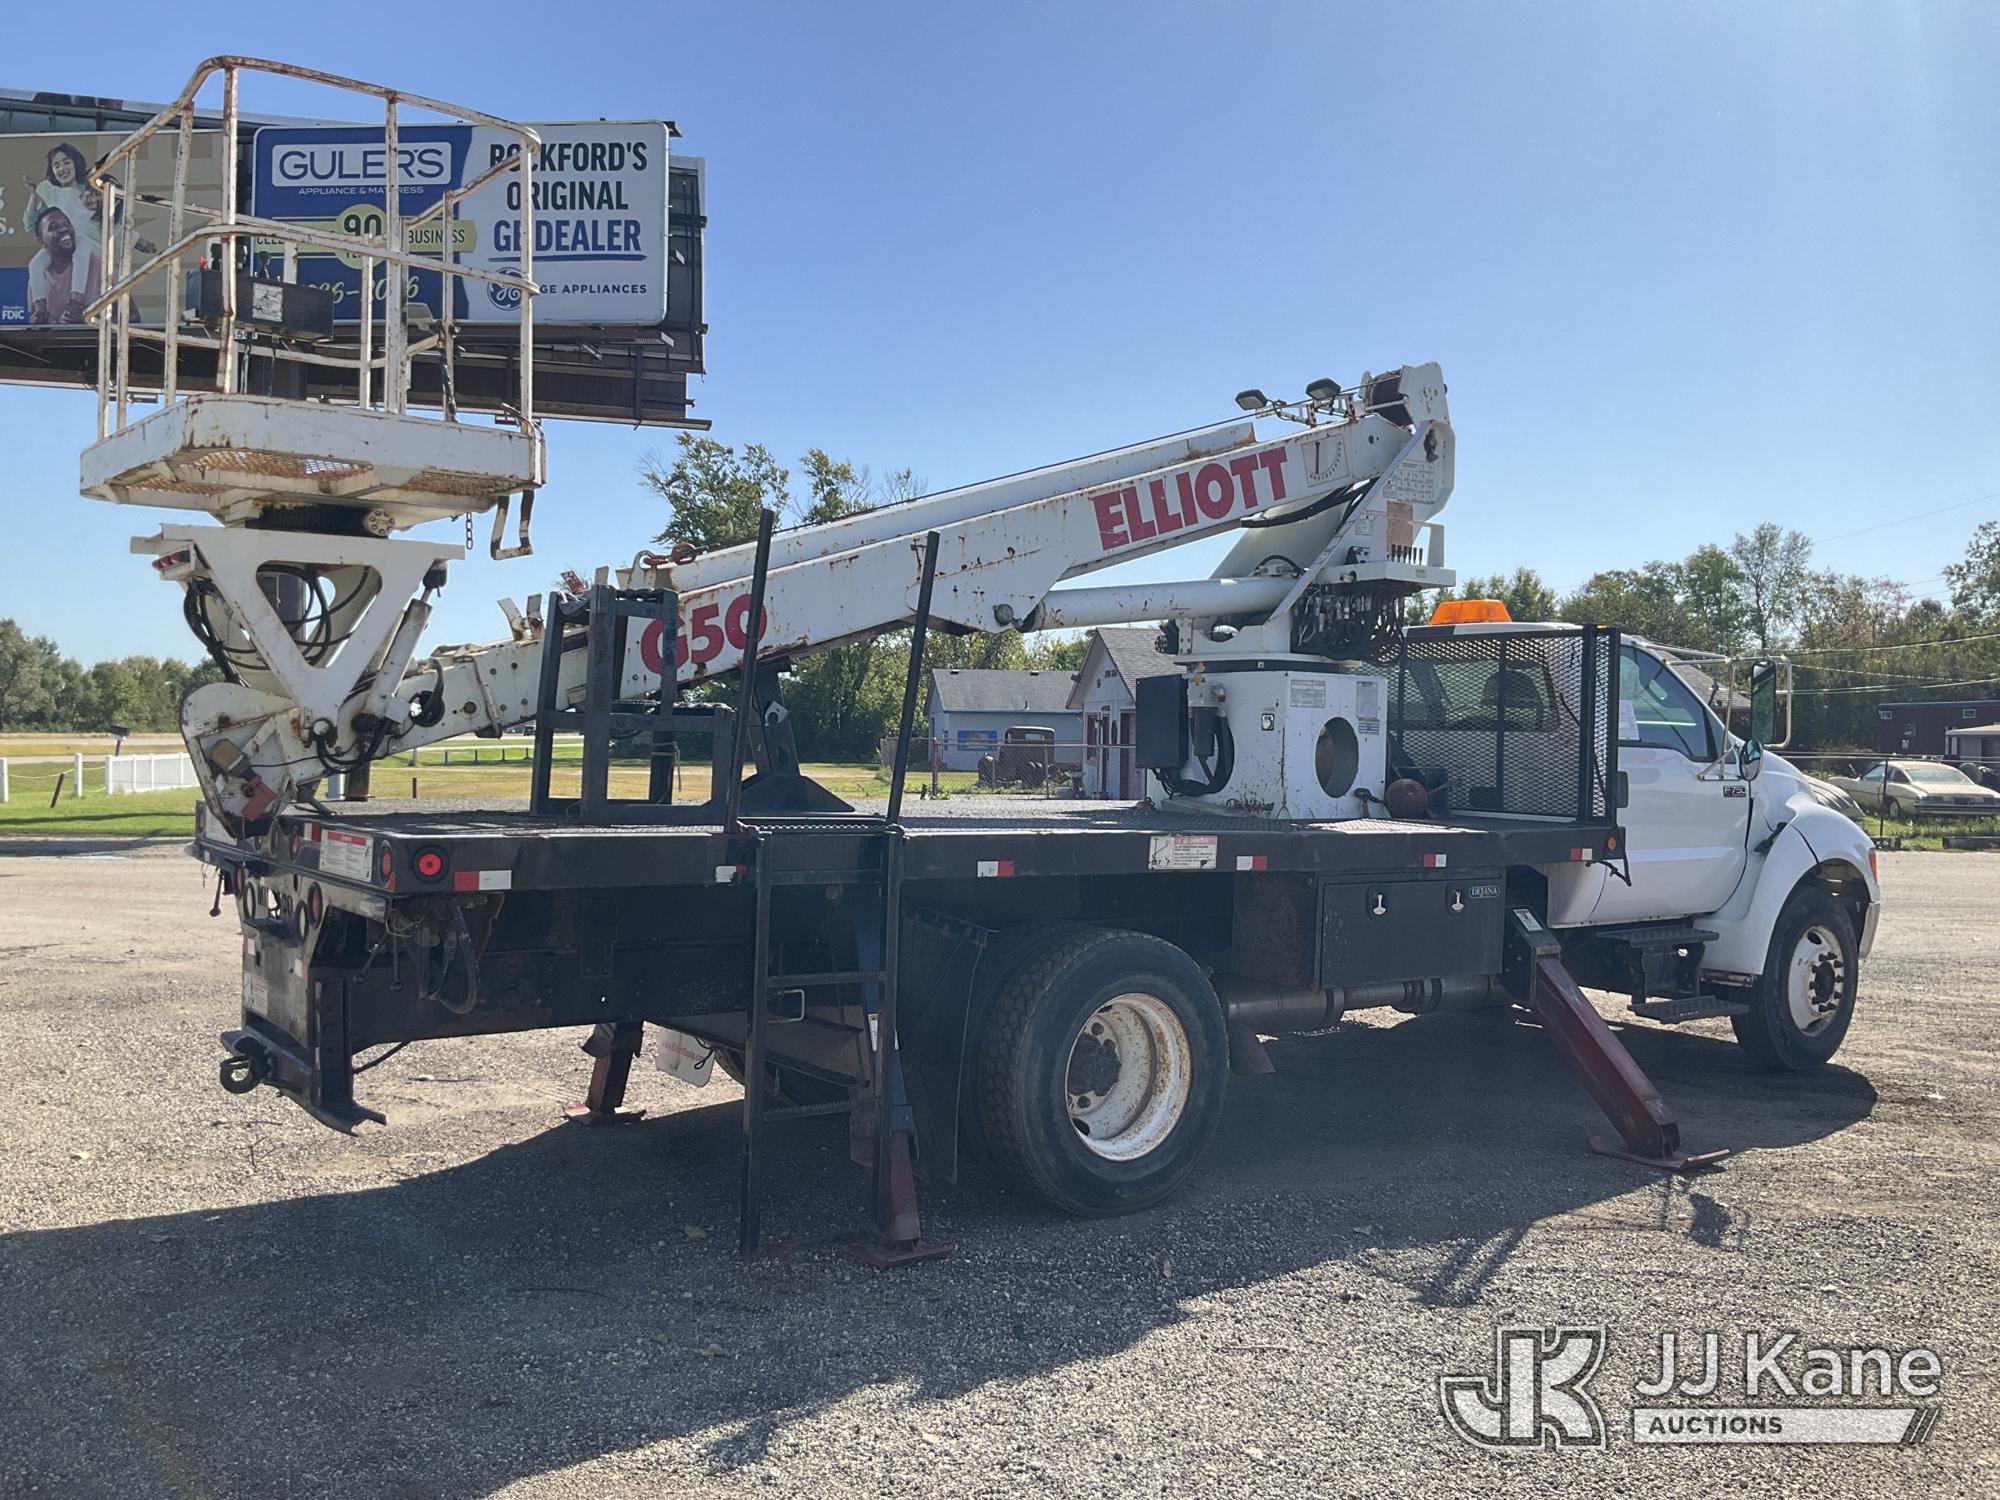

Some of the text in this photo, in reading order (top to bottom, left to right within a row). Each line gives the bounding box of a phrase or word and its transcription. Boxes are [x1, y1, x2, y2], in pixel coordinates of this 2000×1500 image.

[490, 142, 648, 172] ROKFORD'S
[298, 186, 424, 195] APPLIANCE & MARESS
[507, 181, 629, 211] ORIGINAL
[408, 229, 465, 243] BUSINSS
[535, 219, 641, 251] DEALER
[539, 284, 647, 294] GE APPLIANCES
[2, 310, 25, 320] FDIC
[1093, 446, 1288, 551] ELLIOTT
[1471, 886, 1498, 898] DEJANA
